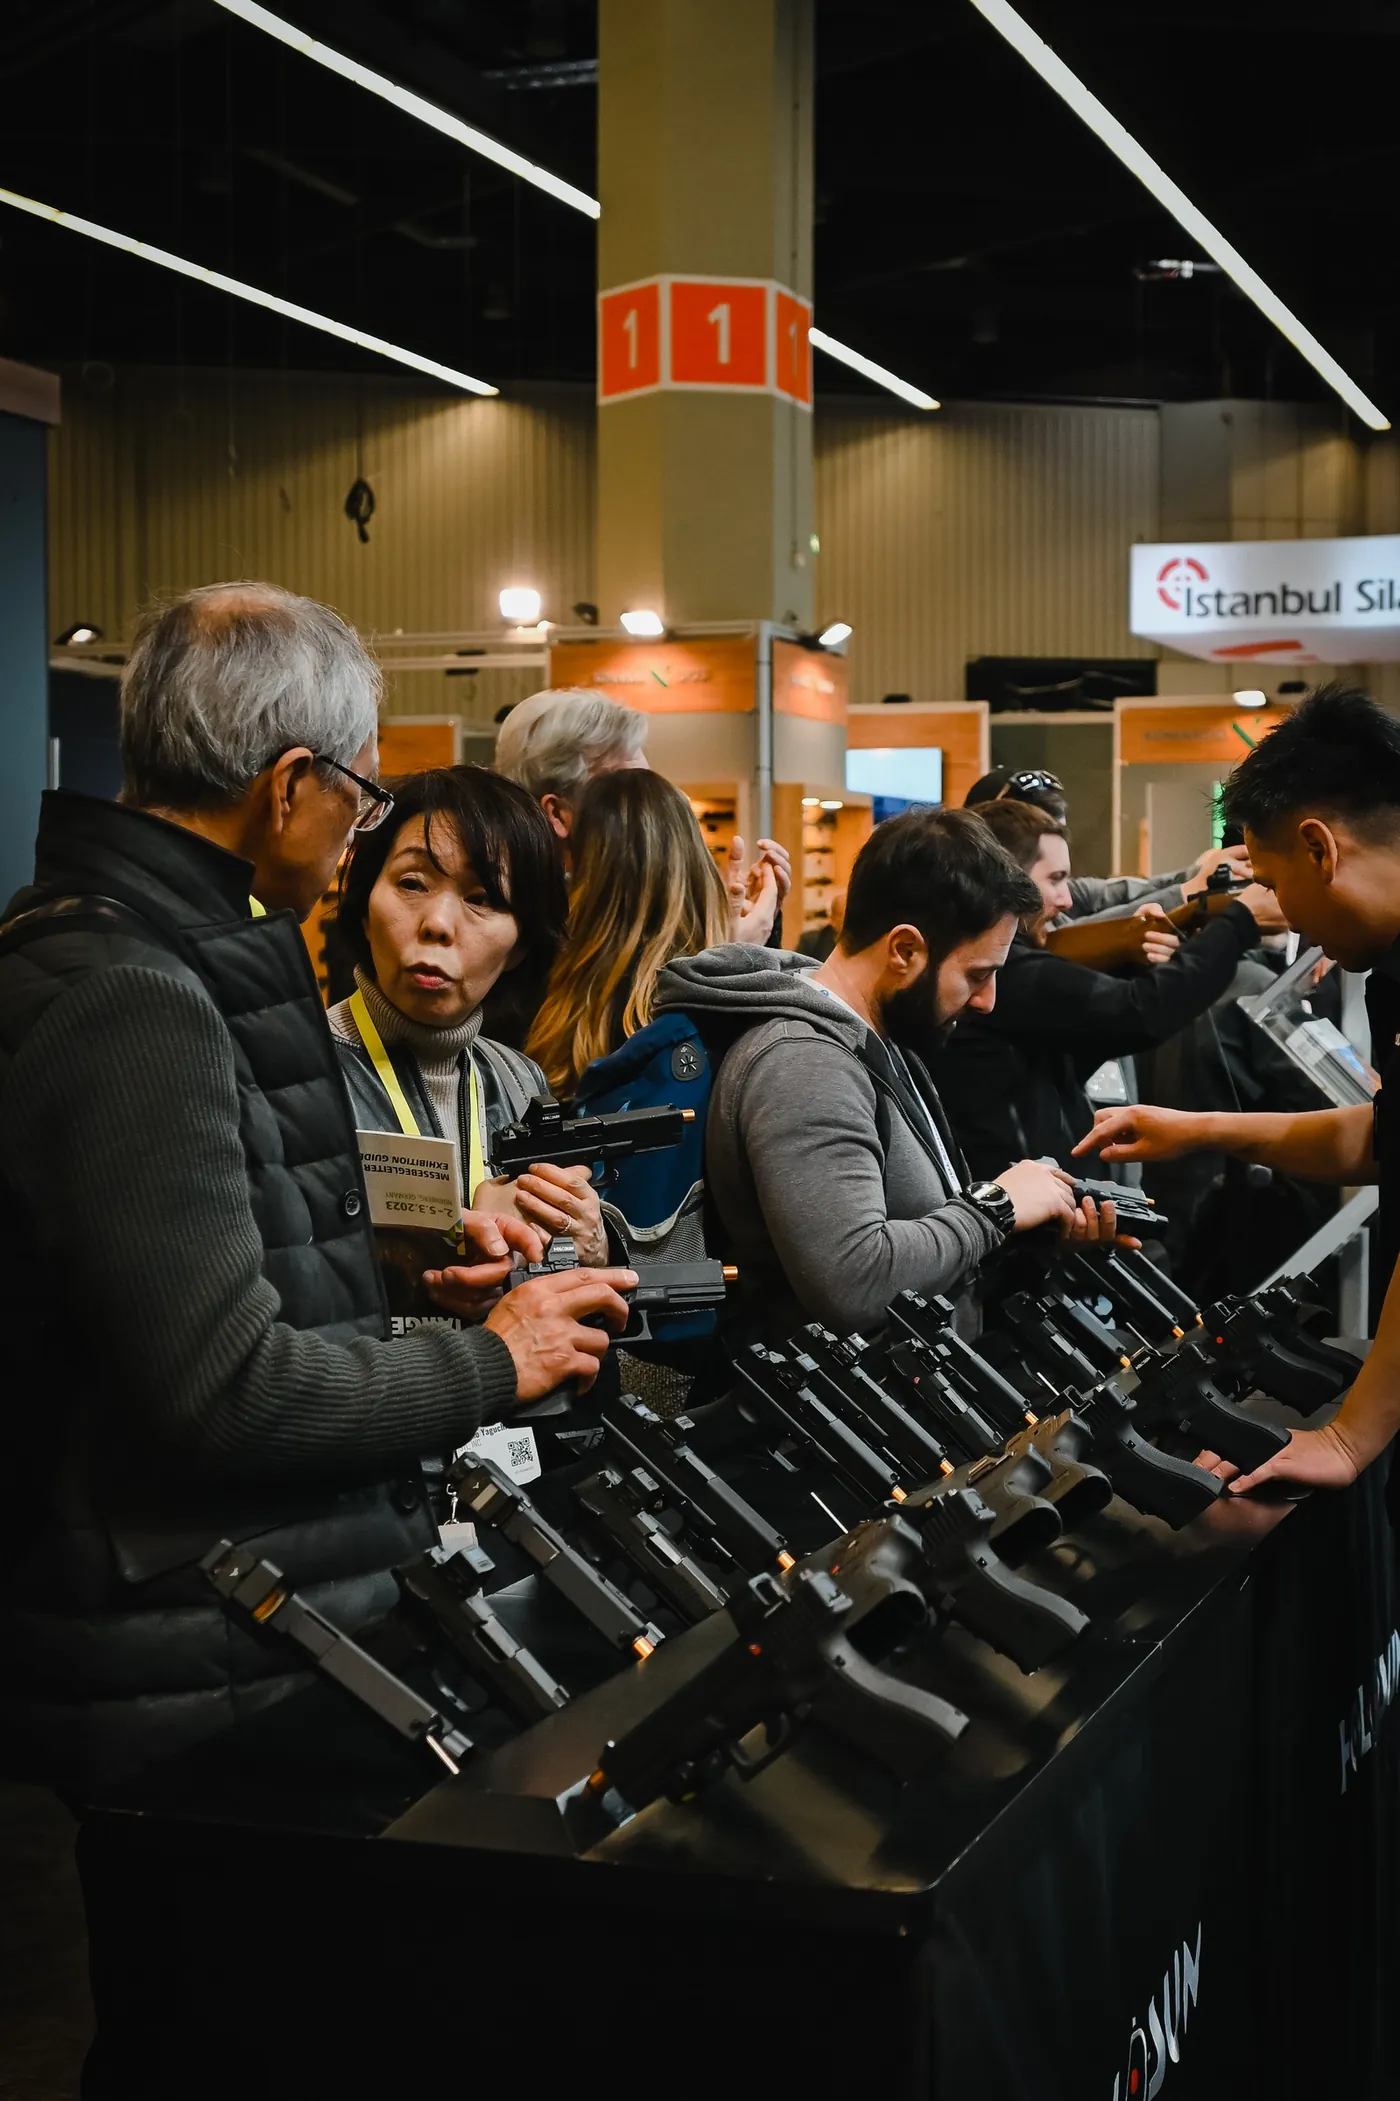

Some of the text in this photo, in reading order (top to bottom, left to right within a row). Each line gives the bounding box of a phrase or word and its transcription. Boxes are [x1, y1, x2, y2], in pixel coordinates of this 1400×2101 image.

[622, 308, 638, 370] 1
[707, 303, 731, 365] 1
[788, 321, 799, 377] 1
[1356, 578, 1400, 613] Sil
[363, 1163, 450, 1181] MESSEBEGLEITER
[391, 1155, 449, 1171] EXHIBITION
